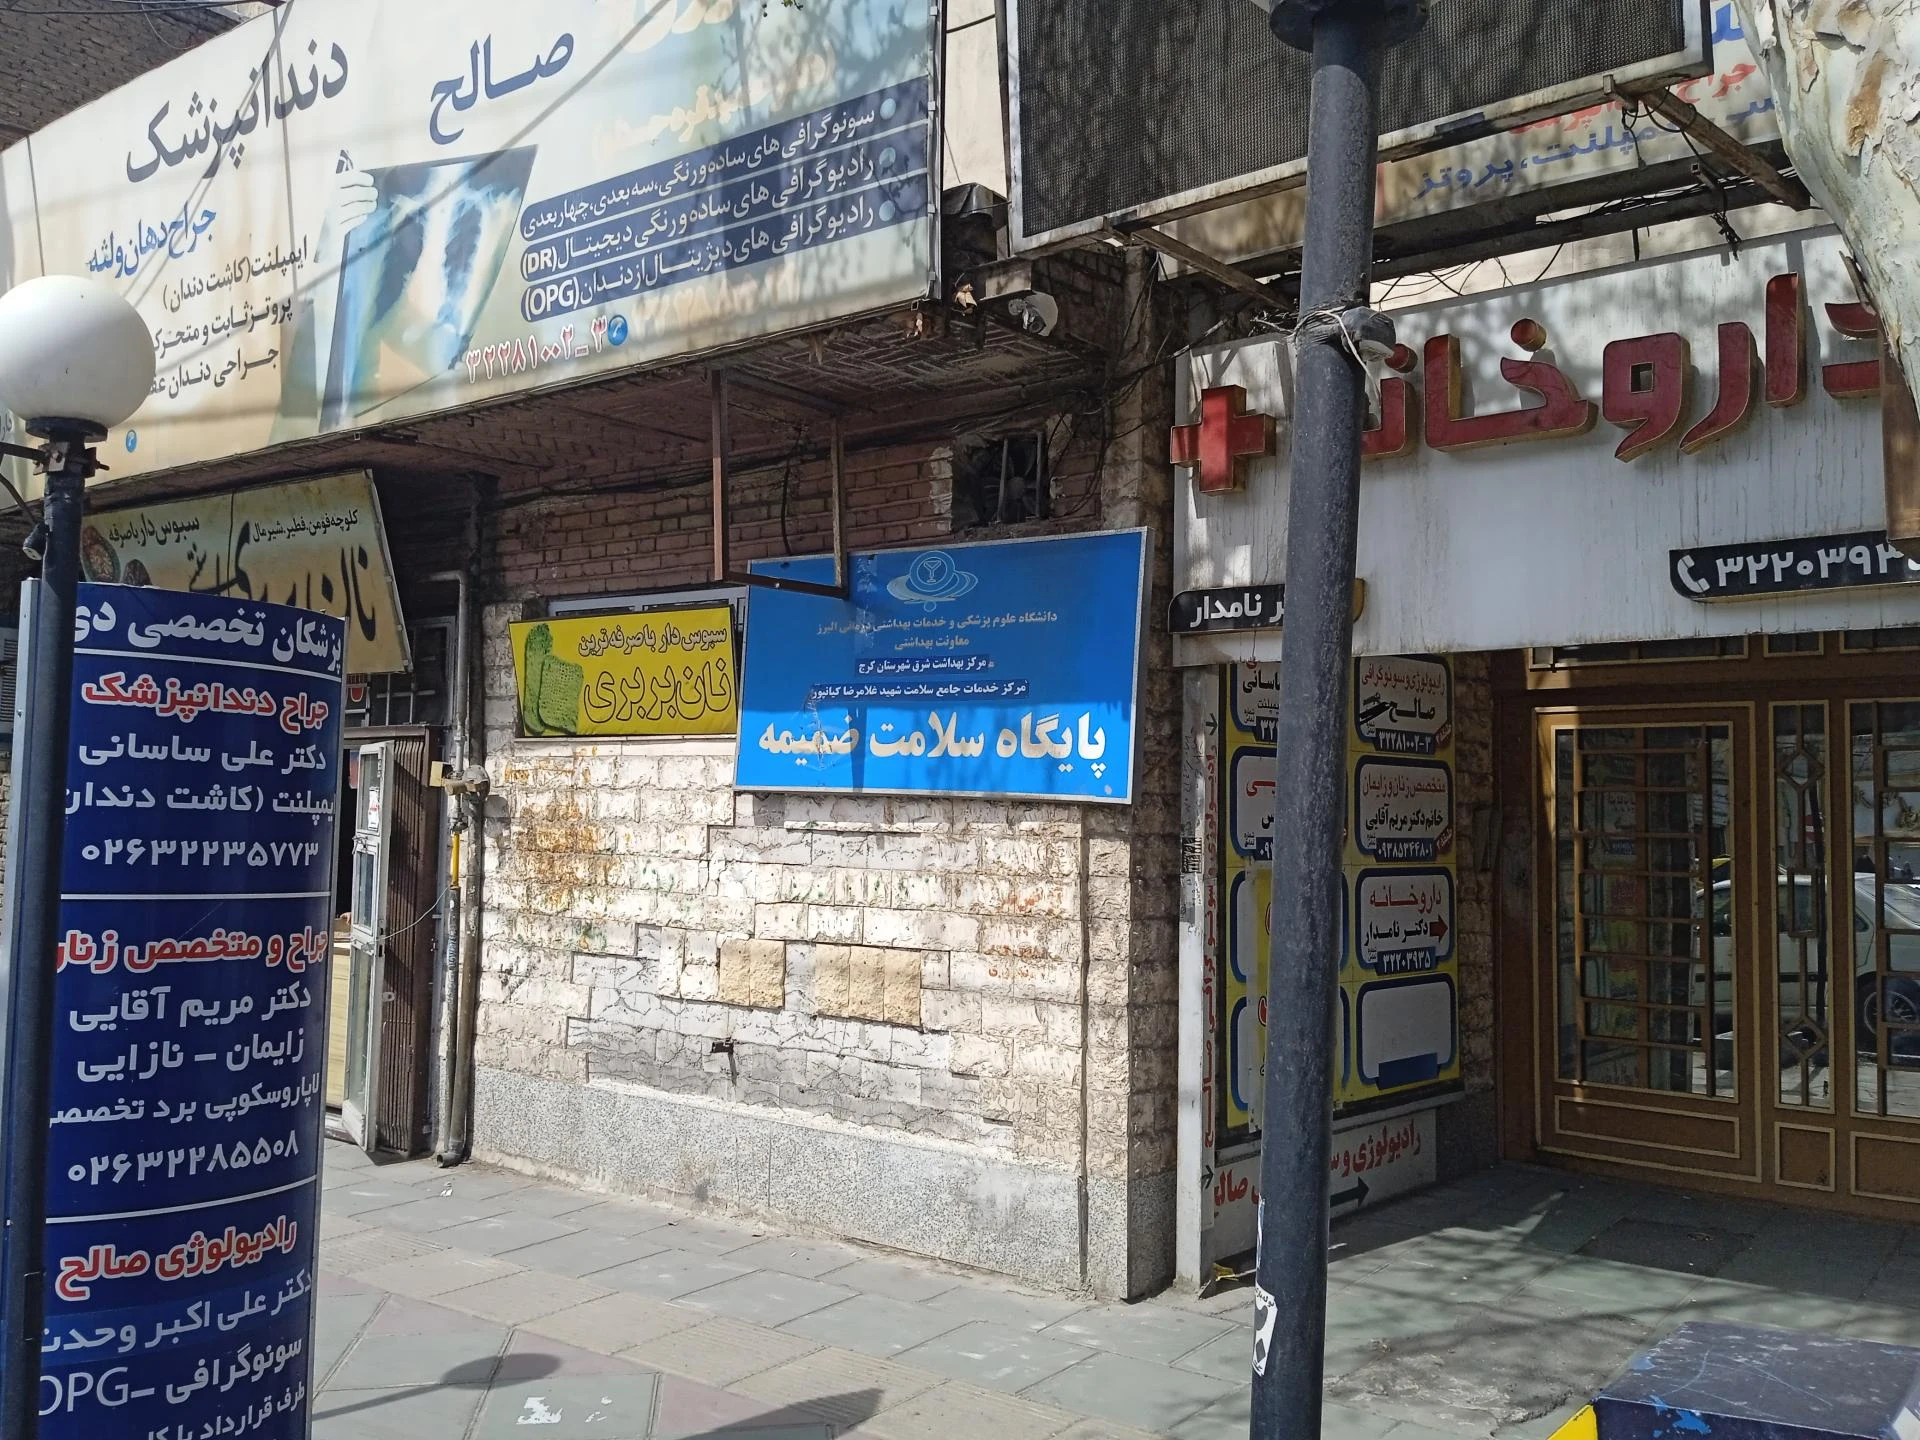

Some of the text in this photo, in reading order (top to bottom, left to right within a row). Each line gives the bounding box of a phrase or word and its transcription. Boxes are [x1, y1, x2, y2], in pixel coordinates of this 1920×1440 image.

[429, 32, 575, 145] صالح
[126, 39, 350, 183] دندانپزشک
[781, 109, 875, 159] سونوگرافی
[772, 147, 874, 209] رادیوگرافی
[772, 195, 874, 255] رادیوگرافی
[168, 361, 211, 399] دندان
[127, 607, 266, 648] تخصصی
[992, 612, 1016, 628] علوم
[1018, 610, 1058, 624] دانشگاه
[1189, 592, 1263, 628] نامدار
[271, 617, 342, 673] پزشکان
[681, 628, 728, 652] سبوس
[935, 634, 970, 650] معاونت
[858, 660, 876, 674] کرج
[876, 659, 911, 674] شهرستان
[912, 658, 931, 672] شرق
[932, 657, 964, 671] بهداشت
[965, 655, 987, 671] مرکز
[1242, 669, 1280, 694] اسانی
[80, 671, 329, 734] جراح دندانپزشک
[583, 657, 732, 724] نان بربری
[842, 685, 878, 698] غلامرضا
[879, 685, 902, 698] شهید
[903, 684, 934, 695] سلامت
[935, 683, 961, 697] جامع
[963, 682, 999, 694] خدمات
[1001, 681, 1027, 696] مرکز
[1388, 696, 1436, 723] صالح
[79, 732, 327, 775] دکتر علی ساسانی
[758, 711, 1107, 780] پایگاه سلامت ضمیمه
[81, 837, 319, 866] ۰۲۶۳۲۲۳۵۷۷۳
[1369, 881, 1442, 914] داروخانه
[124, 927, 262, 974] متخصص
[265, 933, 284, 967] و
[286, 925, 329, 974] جراح
[1363, 918, 1429, 947] دکتر نامدار
[69, 980, 312, 1033] دکتر مریم آقایی
[77, 1039, 185, 1083] نازایی
[226, 1027, 305, 1072] زایمان
[49, 1072, 320, 1129] لاپاروسکوپی برد تخصص
[67, 1129, 300, 1186] ۰۲۶۳۲۲۸۵۵۰۸
[1352, 1118, 1422, 1173] رادیولوژی
[55, 1214, 298, 1301] رادیولوژی صالح
[144, 1300, 210, 1348] اکبر
[217, 1290, 267, 1332] علی
[166, 1337, 302, 1405] سونوگرافی
